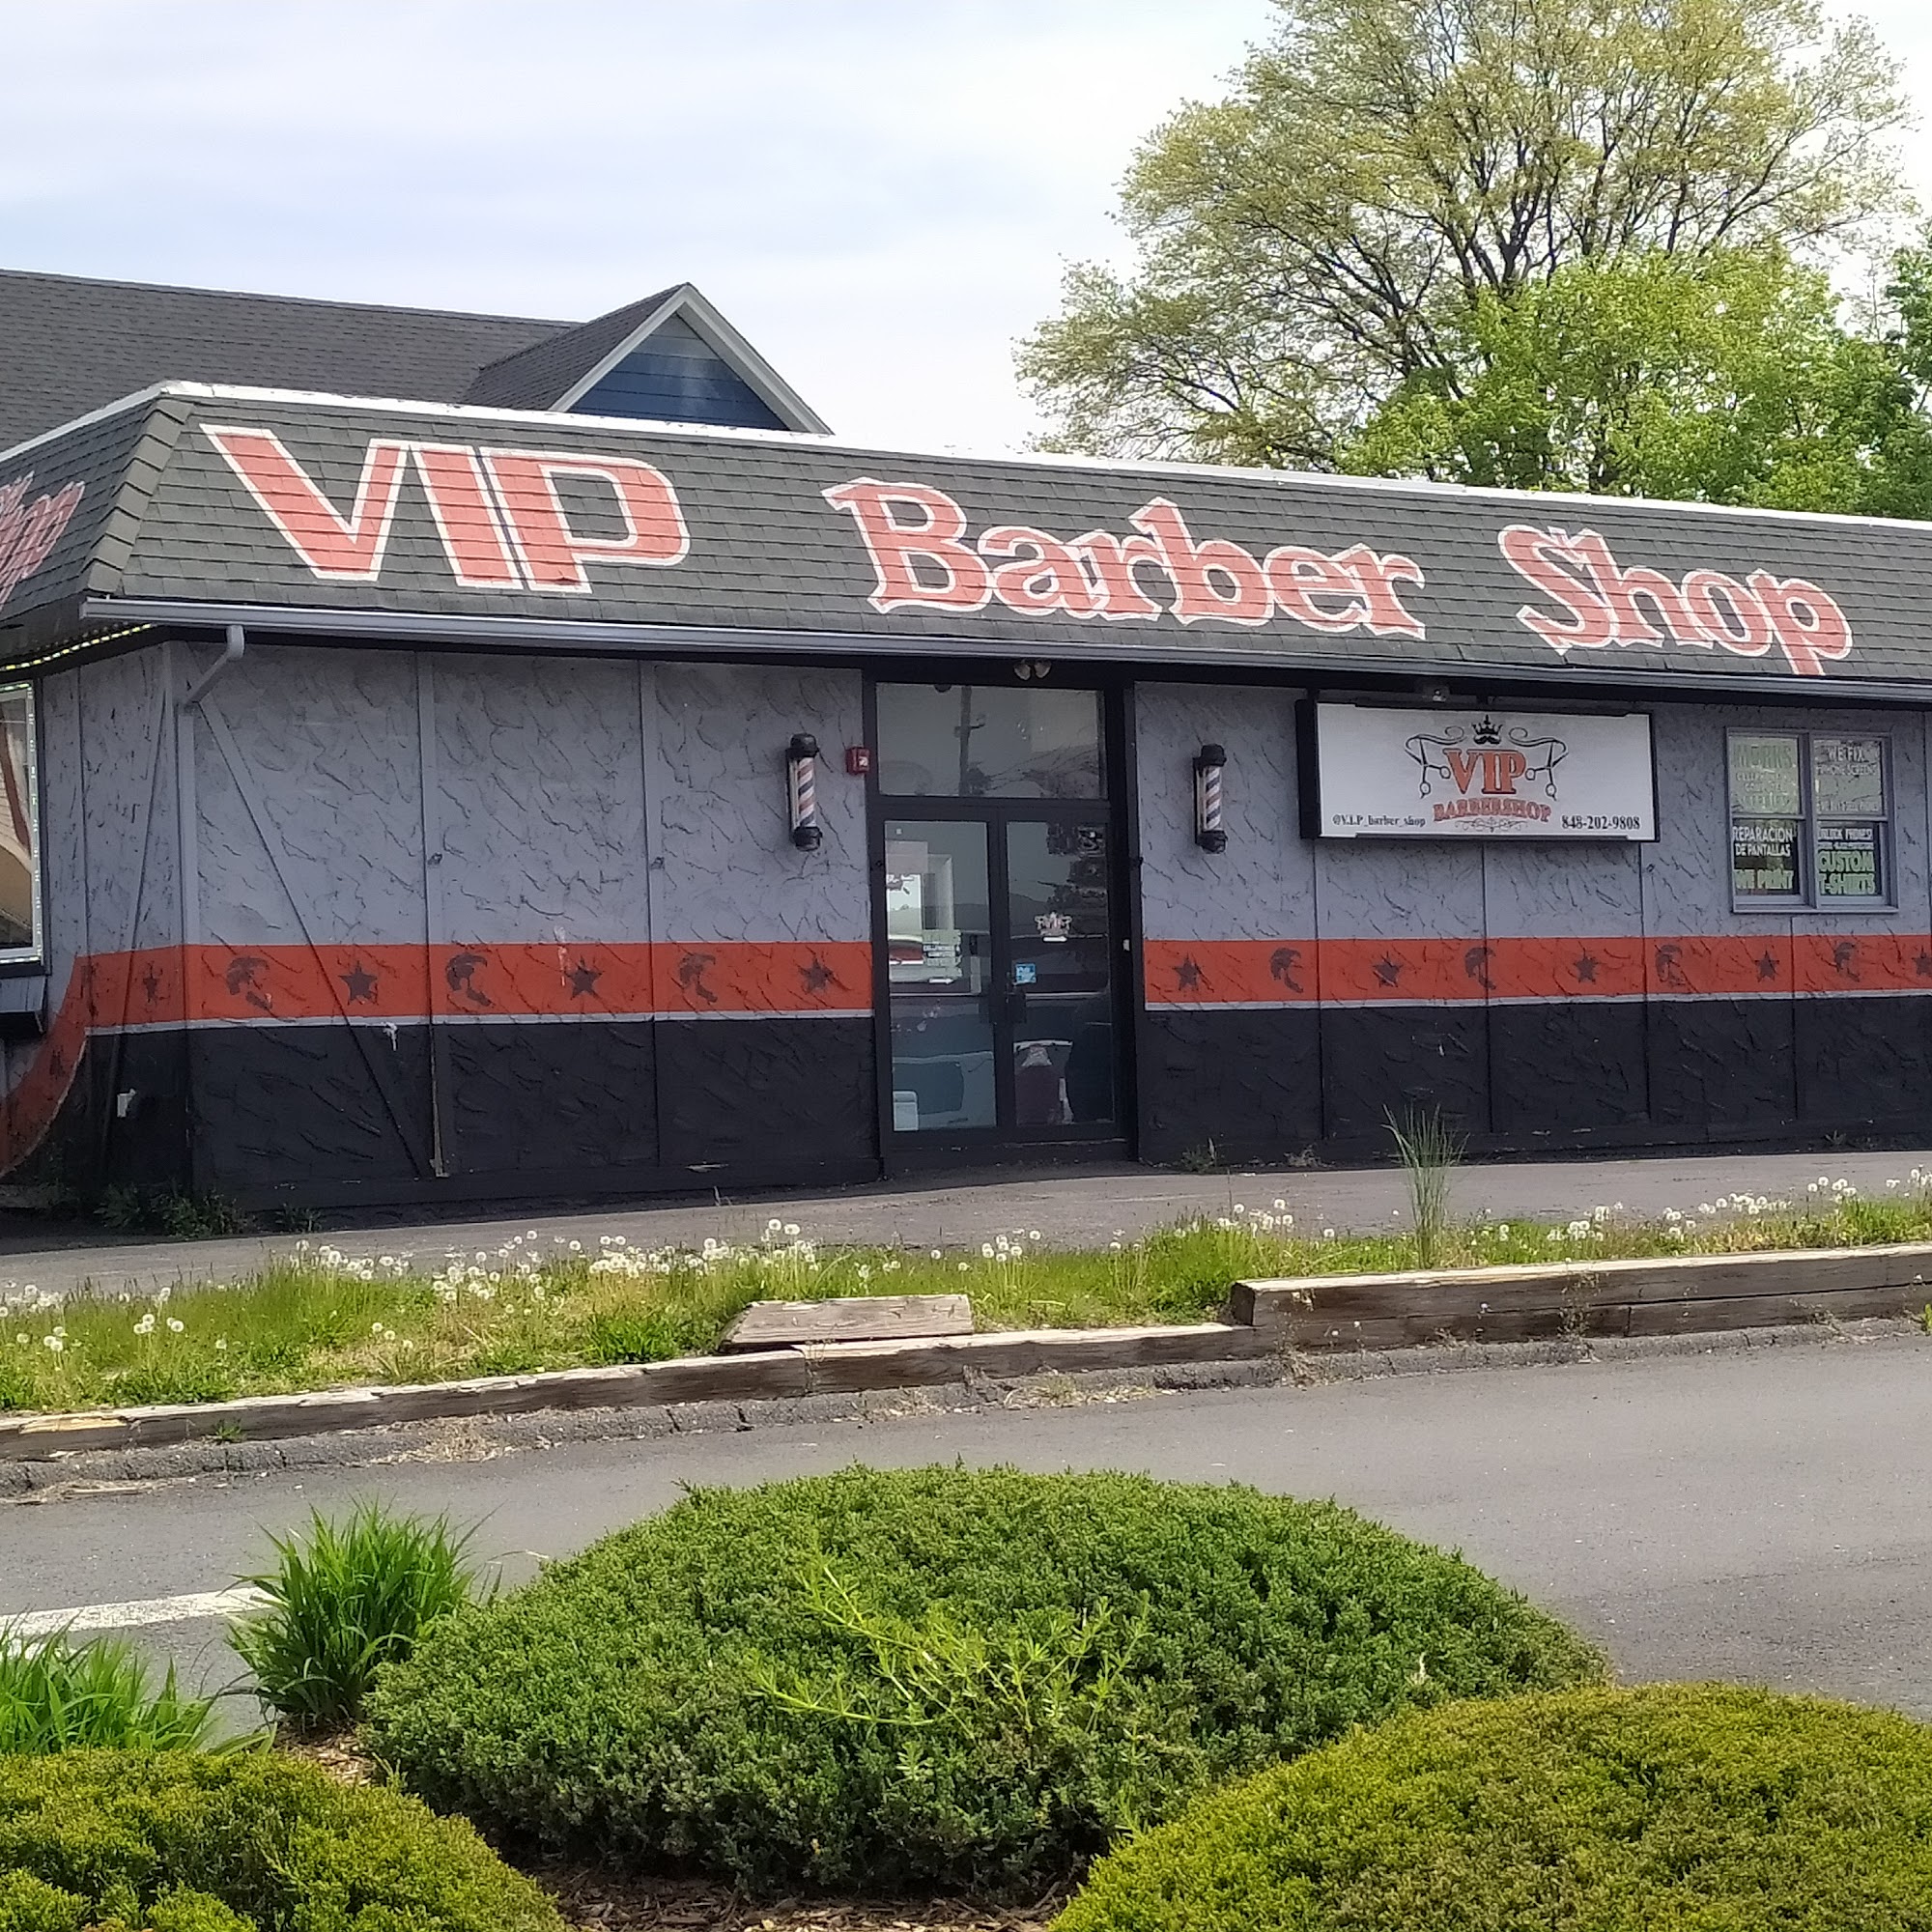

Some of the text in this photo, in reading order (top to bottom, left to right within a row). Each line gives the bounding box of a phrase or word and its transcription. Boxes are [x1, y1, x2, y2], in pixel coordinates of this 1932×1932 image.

[199, 423, 1854, 675] VIP Barber Shop
[1442, 748, 1526, 794] VIP
[1433, 797, 1552, 822] BARBERSHOP
[1561, 814, 1641, 830] 848-202-9808
[1735, 843, 1747, 856] DE
[1818, 850, 1875, 871] CUSTOM
